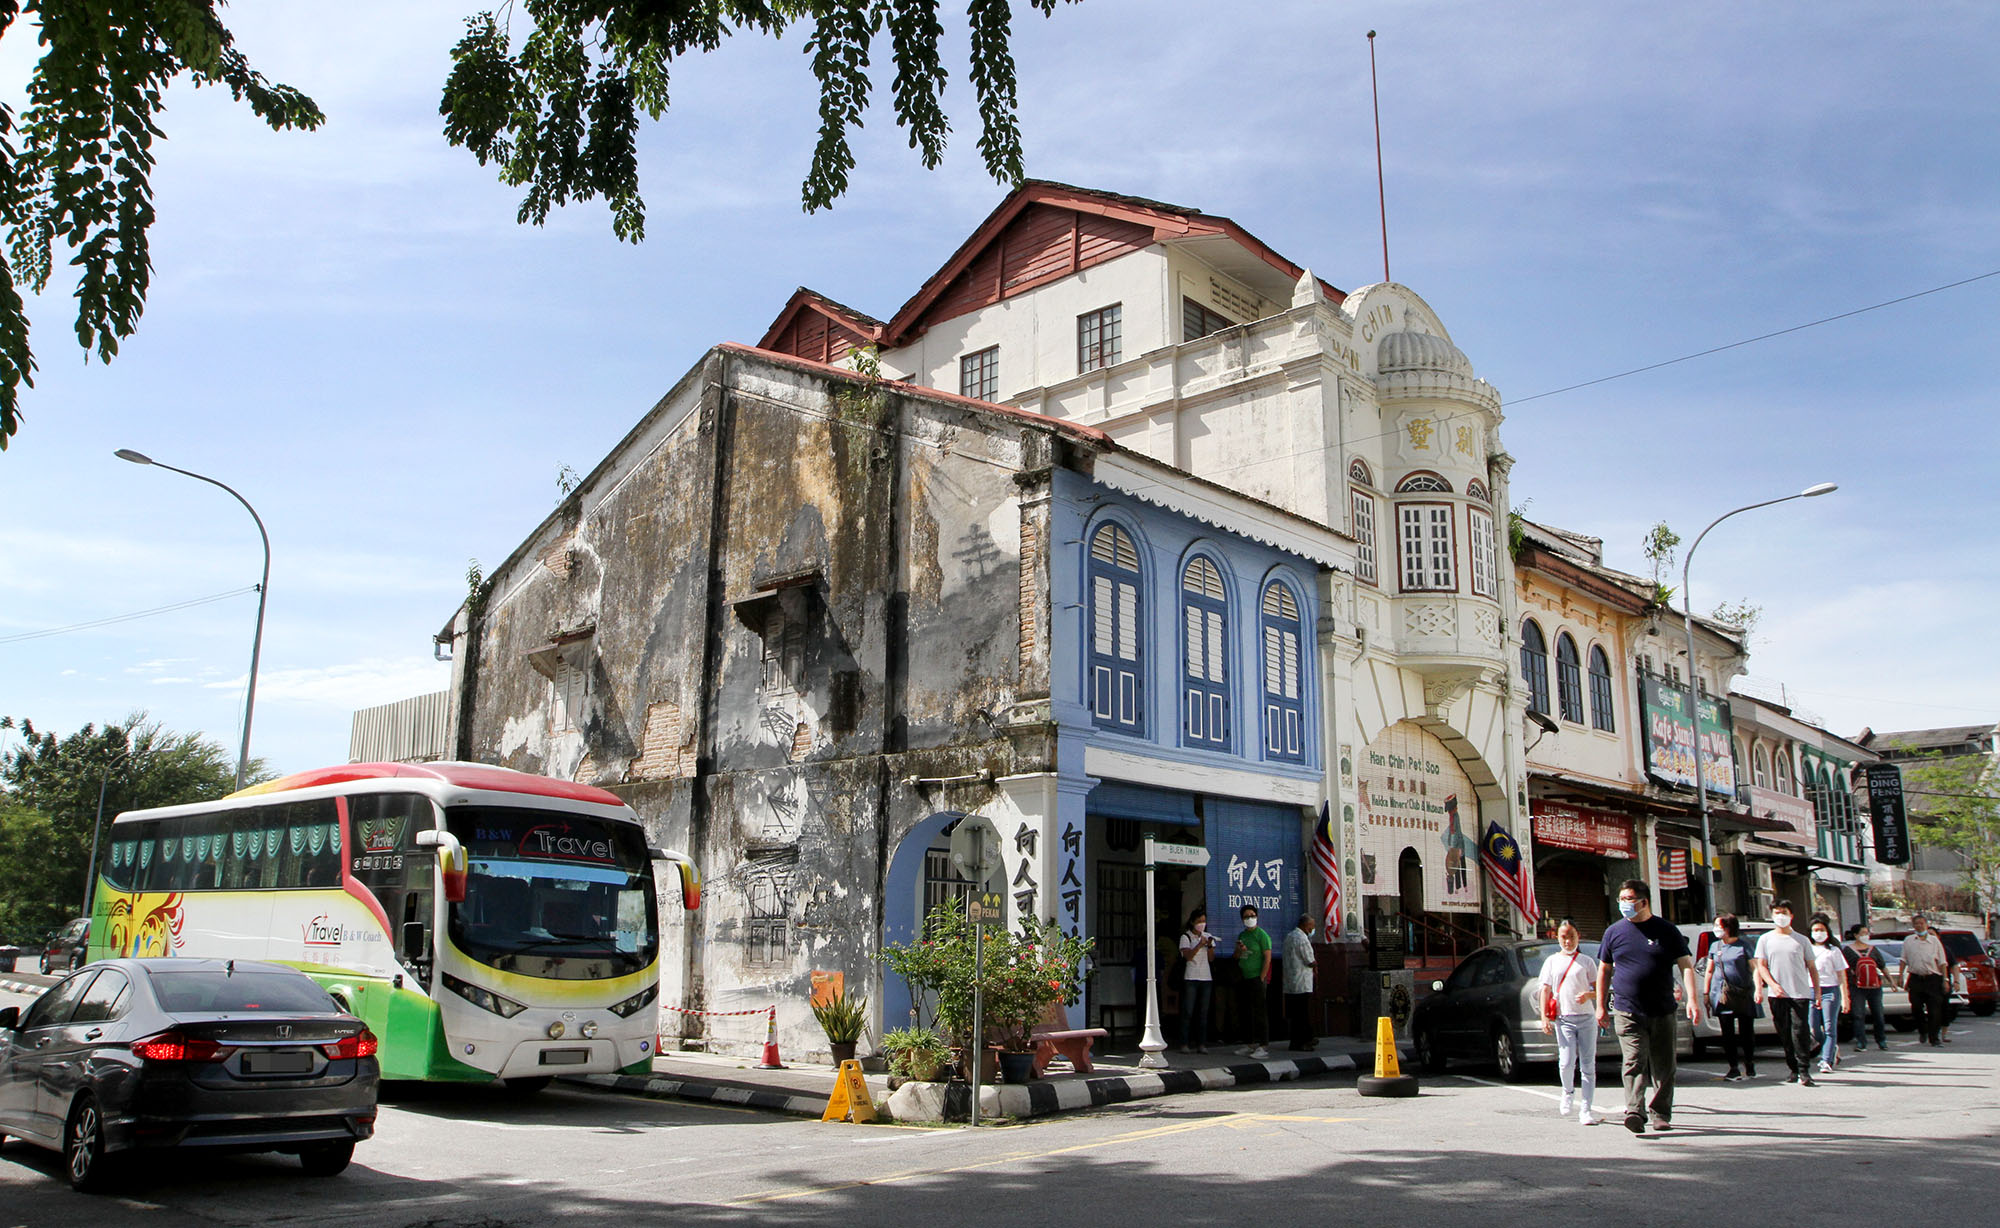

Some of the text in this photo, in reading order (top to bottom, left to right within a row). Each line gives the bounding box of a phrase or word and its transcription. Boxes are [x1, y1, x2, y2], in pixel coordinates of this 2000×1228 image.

[1361, 304, 1393, 343] CHIN
[1652, 712, 1672, 746] Kafe
[1710, 731, 1730, 758] Wah
[1370, 750, 1440, 775] Han Chin Pet Soo
[1870, 778, 1899, 788] DING
[1871, 788, 1900, 797] FENG
[534, 830, 615, 859] Travel
[1227, 854, 1284, 892] 何人可
[1228, 894, 1280, 910] HO YAN HOR
[982, 908, 1000, 919] PEKAN
[312, 923, 343, 941] Travel
[363, 931, 382, 942] Coach
[1387, 1054, 1393, 1064] P
